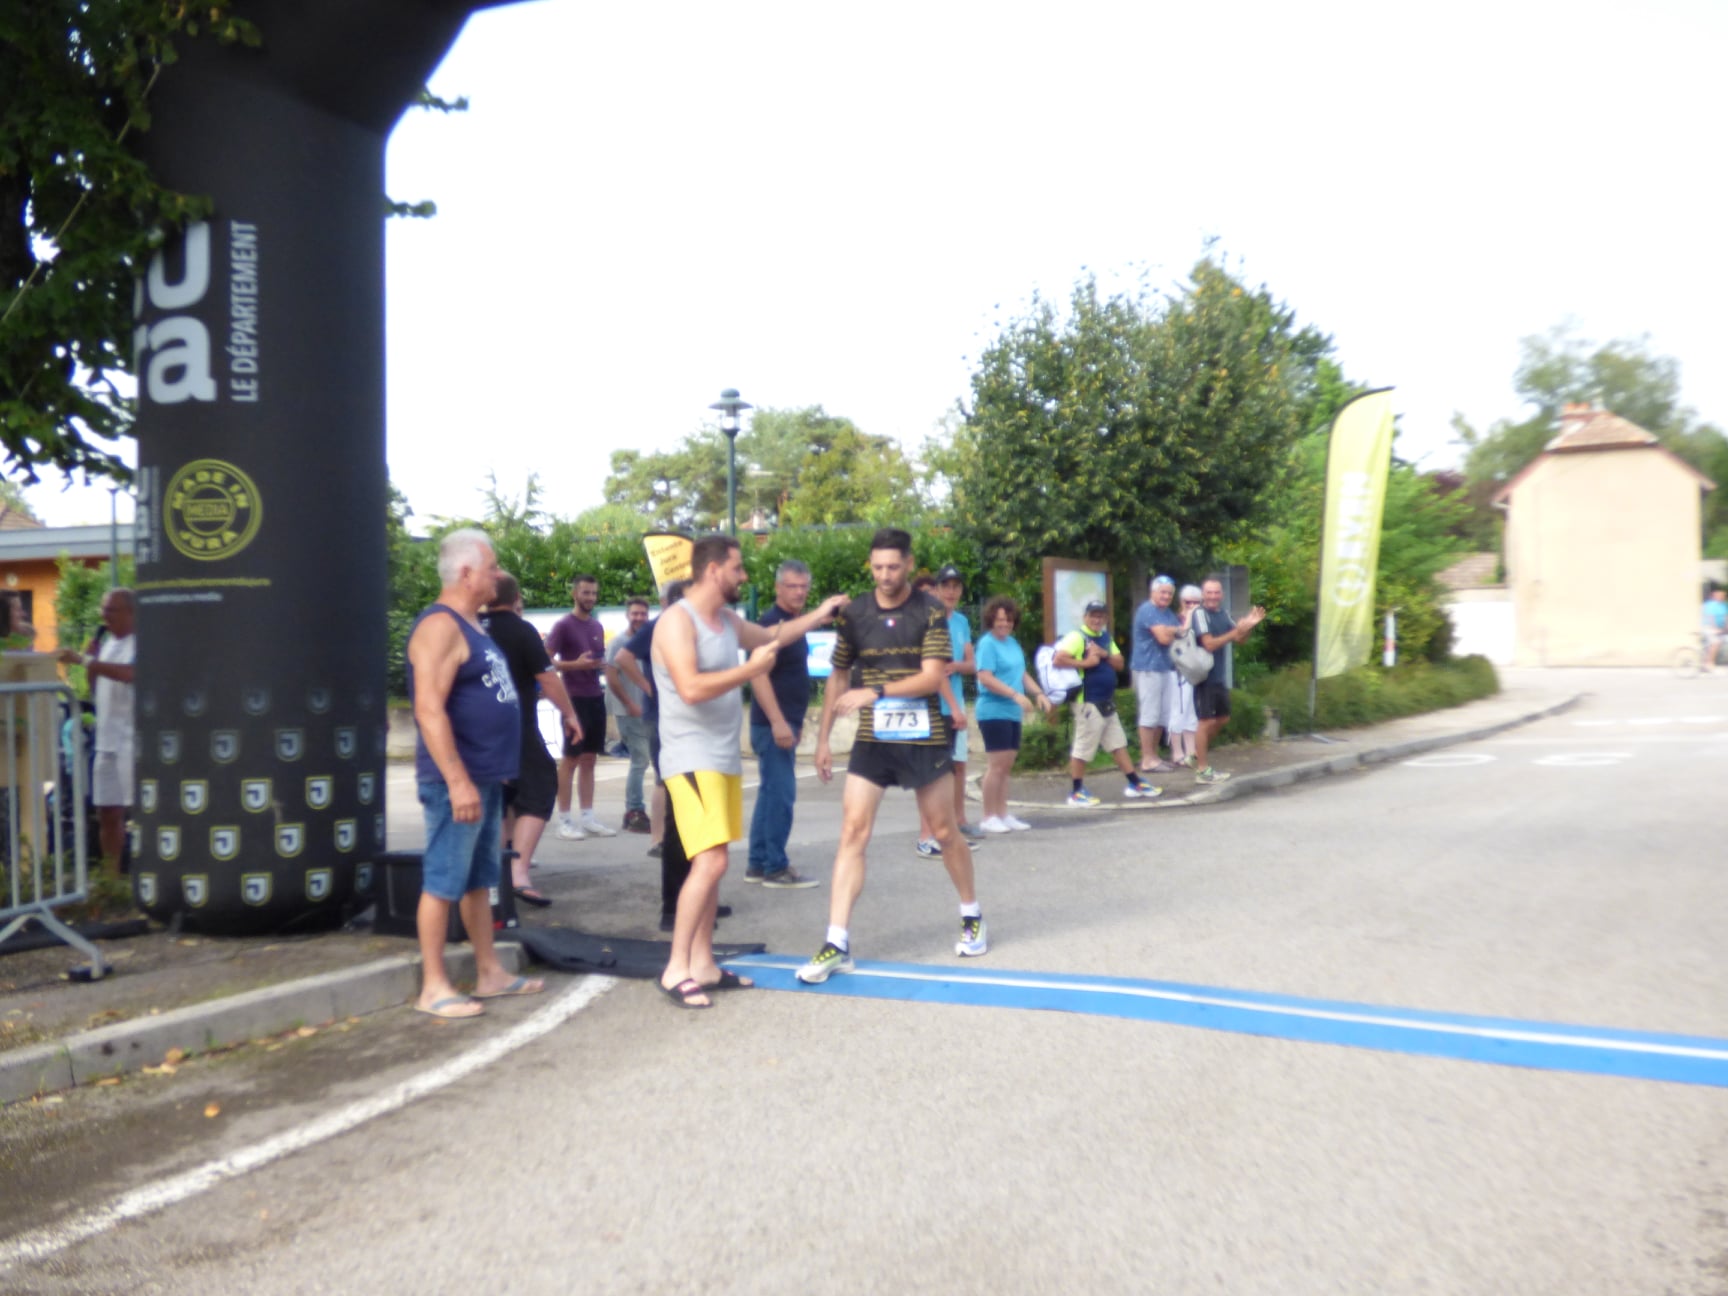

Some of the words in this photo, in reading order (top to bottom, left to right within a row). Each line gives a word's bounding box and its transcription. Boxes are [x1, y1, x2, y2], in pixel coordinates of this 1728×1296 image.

[225, 220, 258, 373] DÉPARTEMENT
[230, 378, 258, 402] LE
[172, 470, 225, 510] MADE
[883, 711, 919, 729] 773
